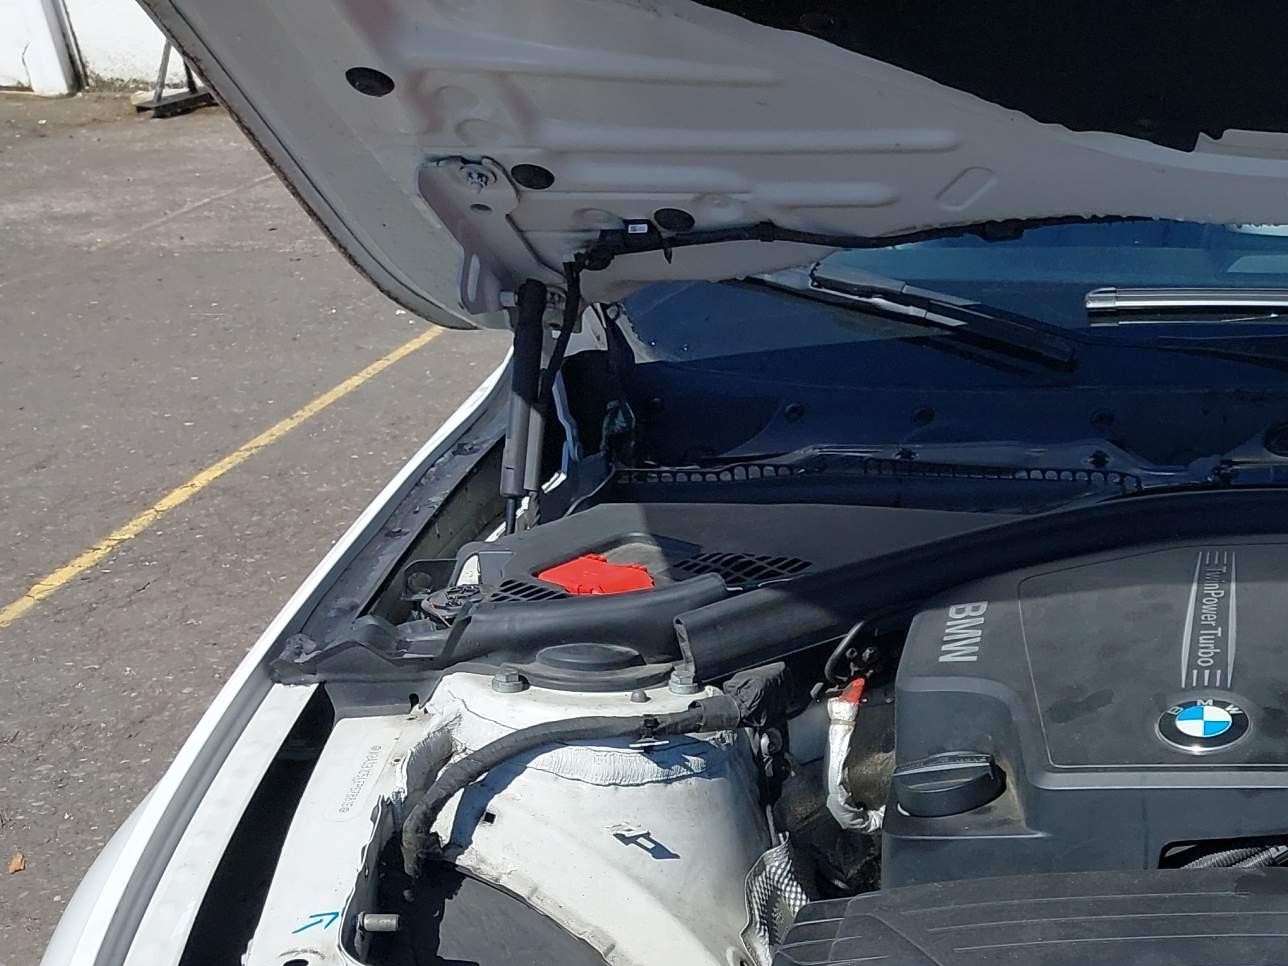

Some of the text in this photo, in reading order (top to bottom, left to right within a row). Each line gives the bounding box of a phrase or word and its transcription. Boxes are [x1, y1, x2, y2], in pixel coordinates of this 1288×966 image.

[938, 600, 988, 662] BMW
[1197, 566, 1226, 666] TwinPower Turbo
[1168, 699, 1243, 715] BMW
